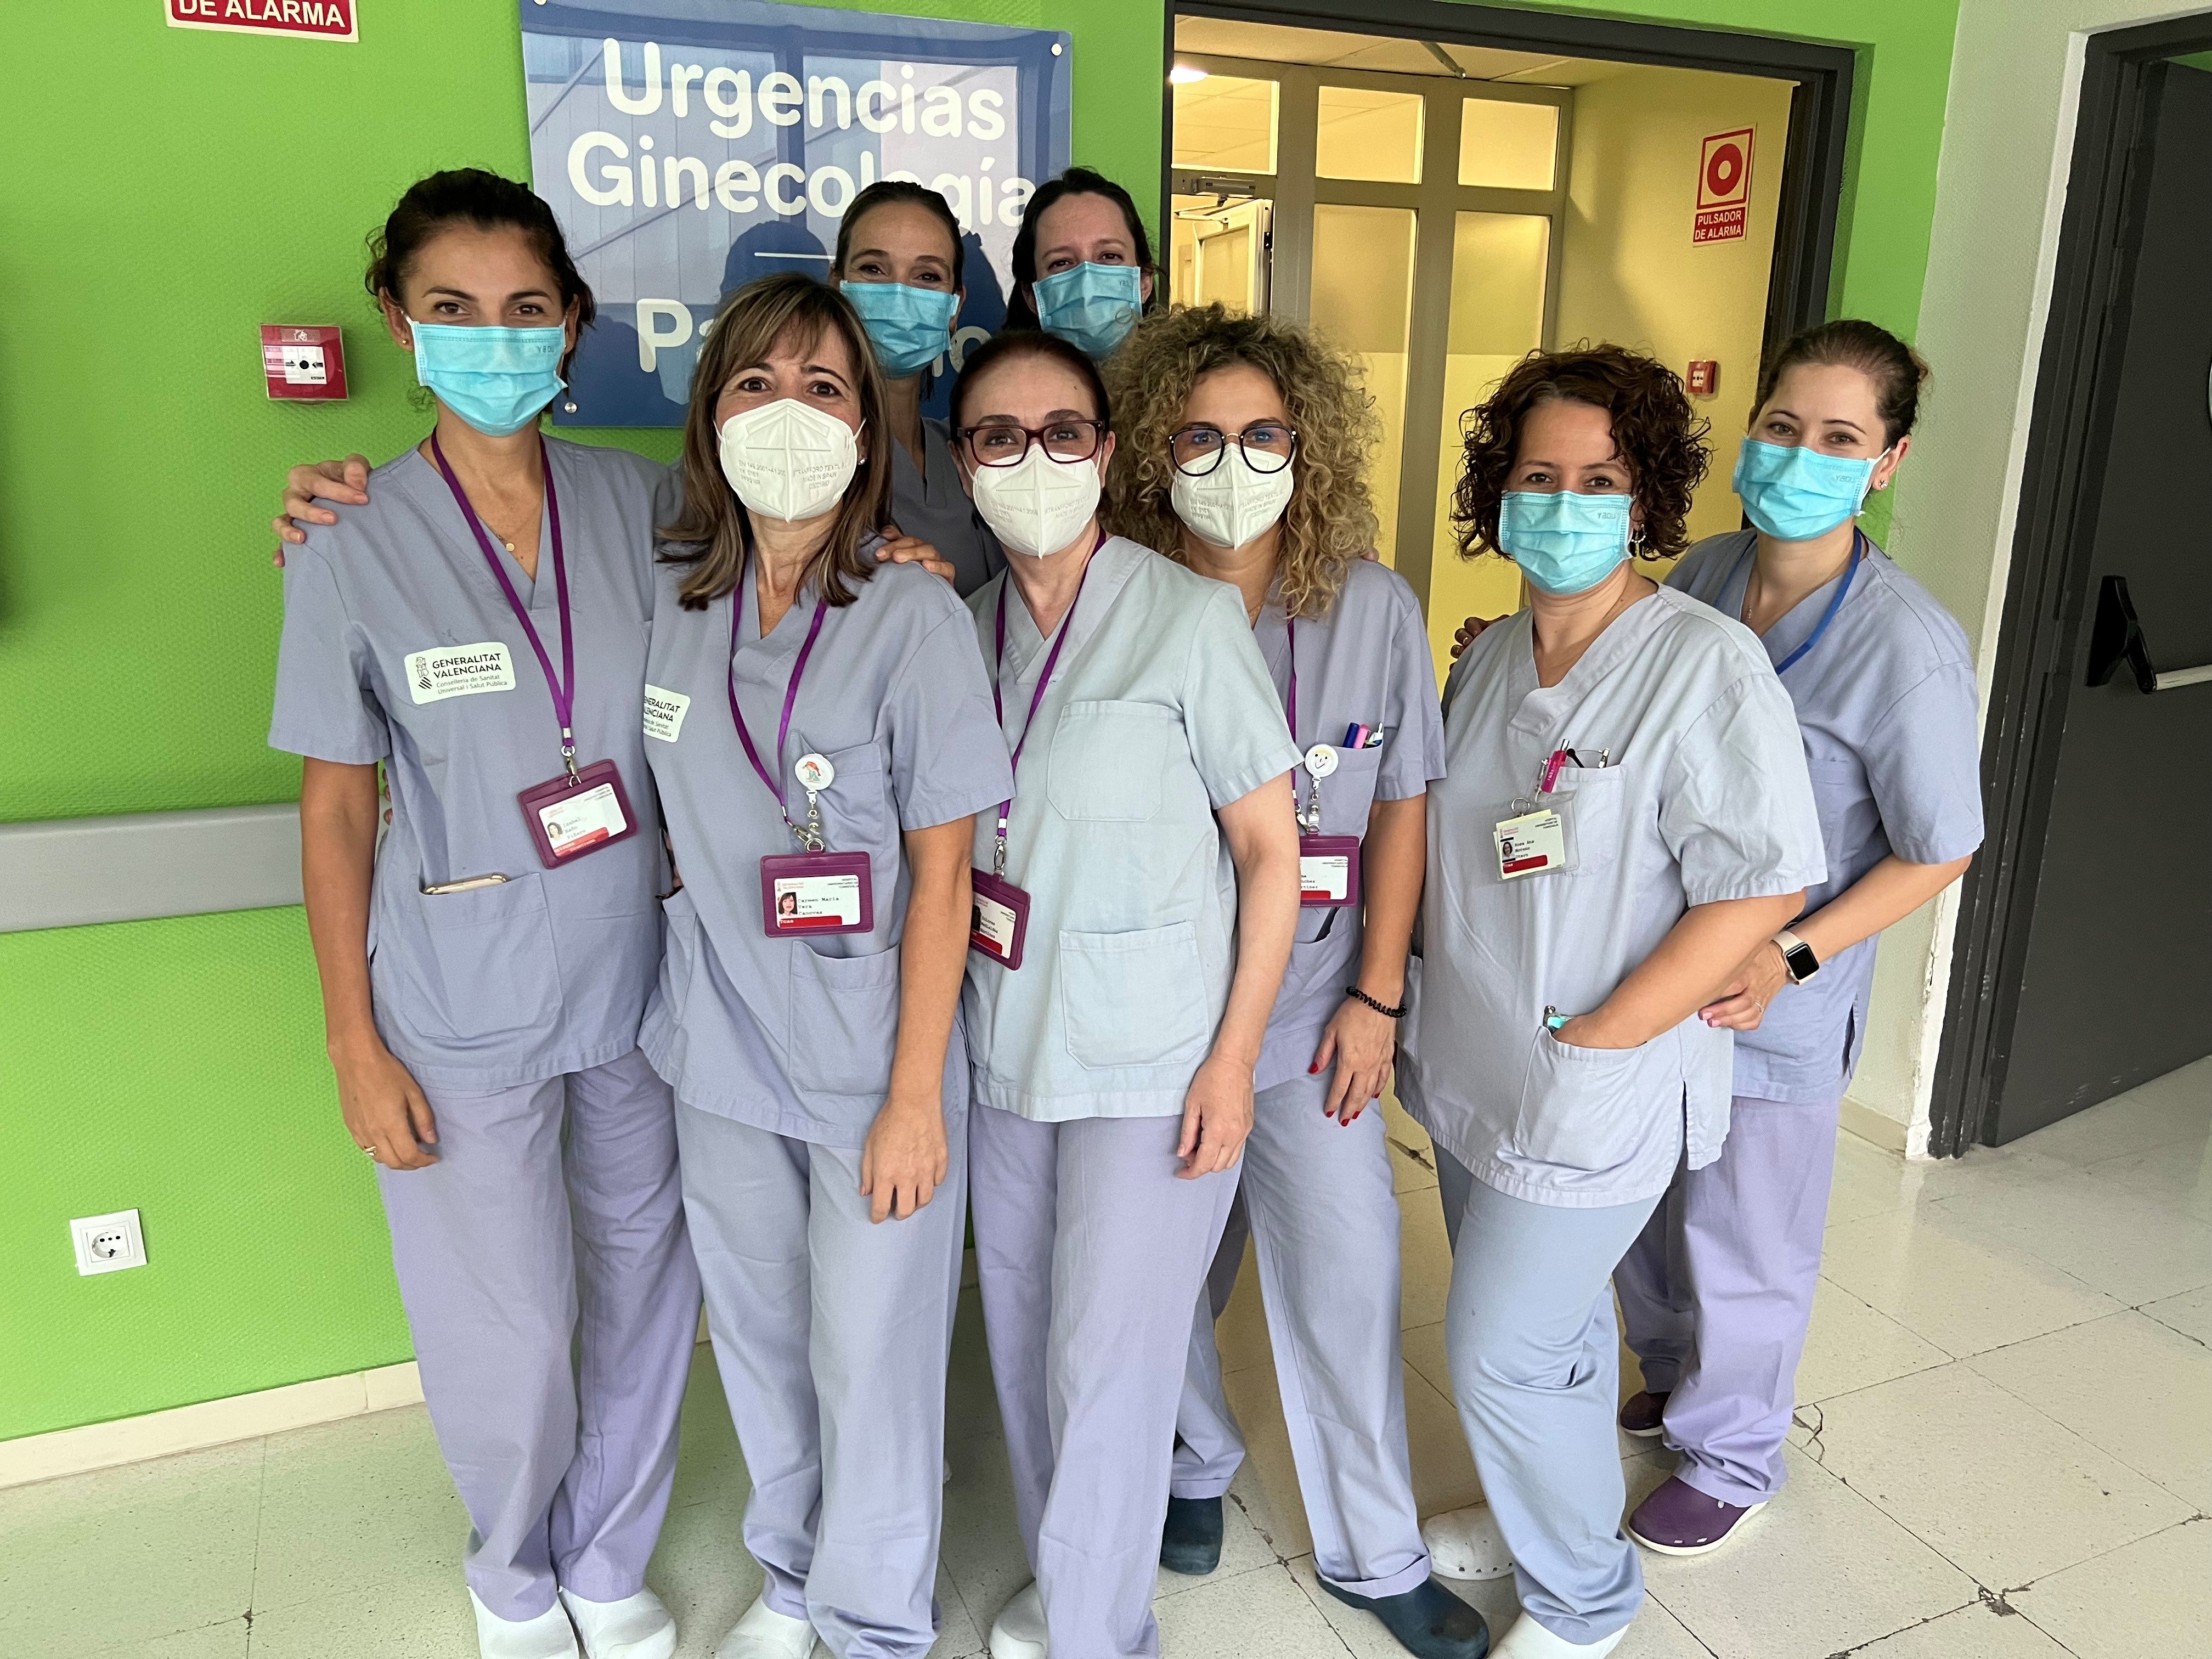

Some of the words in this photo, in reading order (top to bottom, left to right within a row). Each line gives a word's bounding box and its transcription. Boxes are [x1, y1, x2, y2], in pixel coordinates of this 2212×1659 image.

[179, 0, 217, 16] DE
[225, 0, 346, 27] ALARMA
[603, 37, 1005, 141] Urgencias
[568, 131, 1036, 237] Ginecolgía
[1697, 210, 1741, 226] PULSADOR
[1695, 229, 1706, 240] DE
[1707, 225, 1742, 239] ALARMA
[432, 653, 501, 669] GENERALITAT
[433, 663, 502, 679] VALENCIANA
[438, 685, 465, 695] Universal
